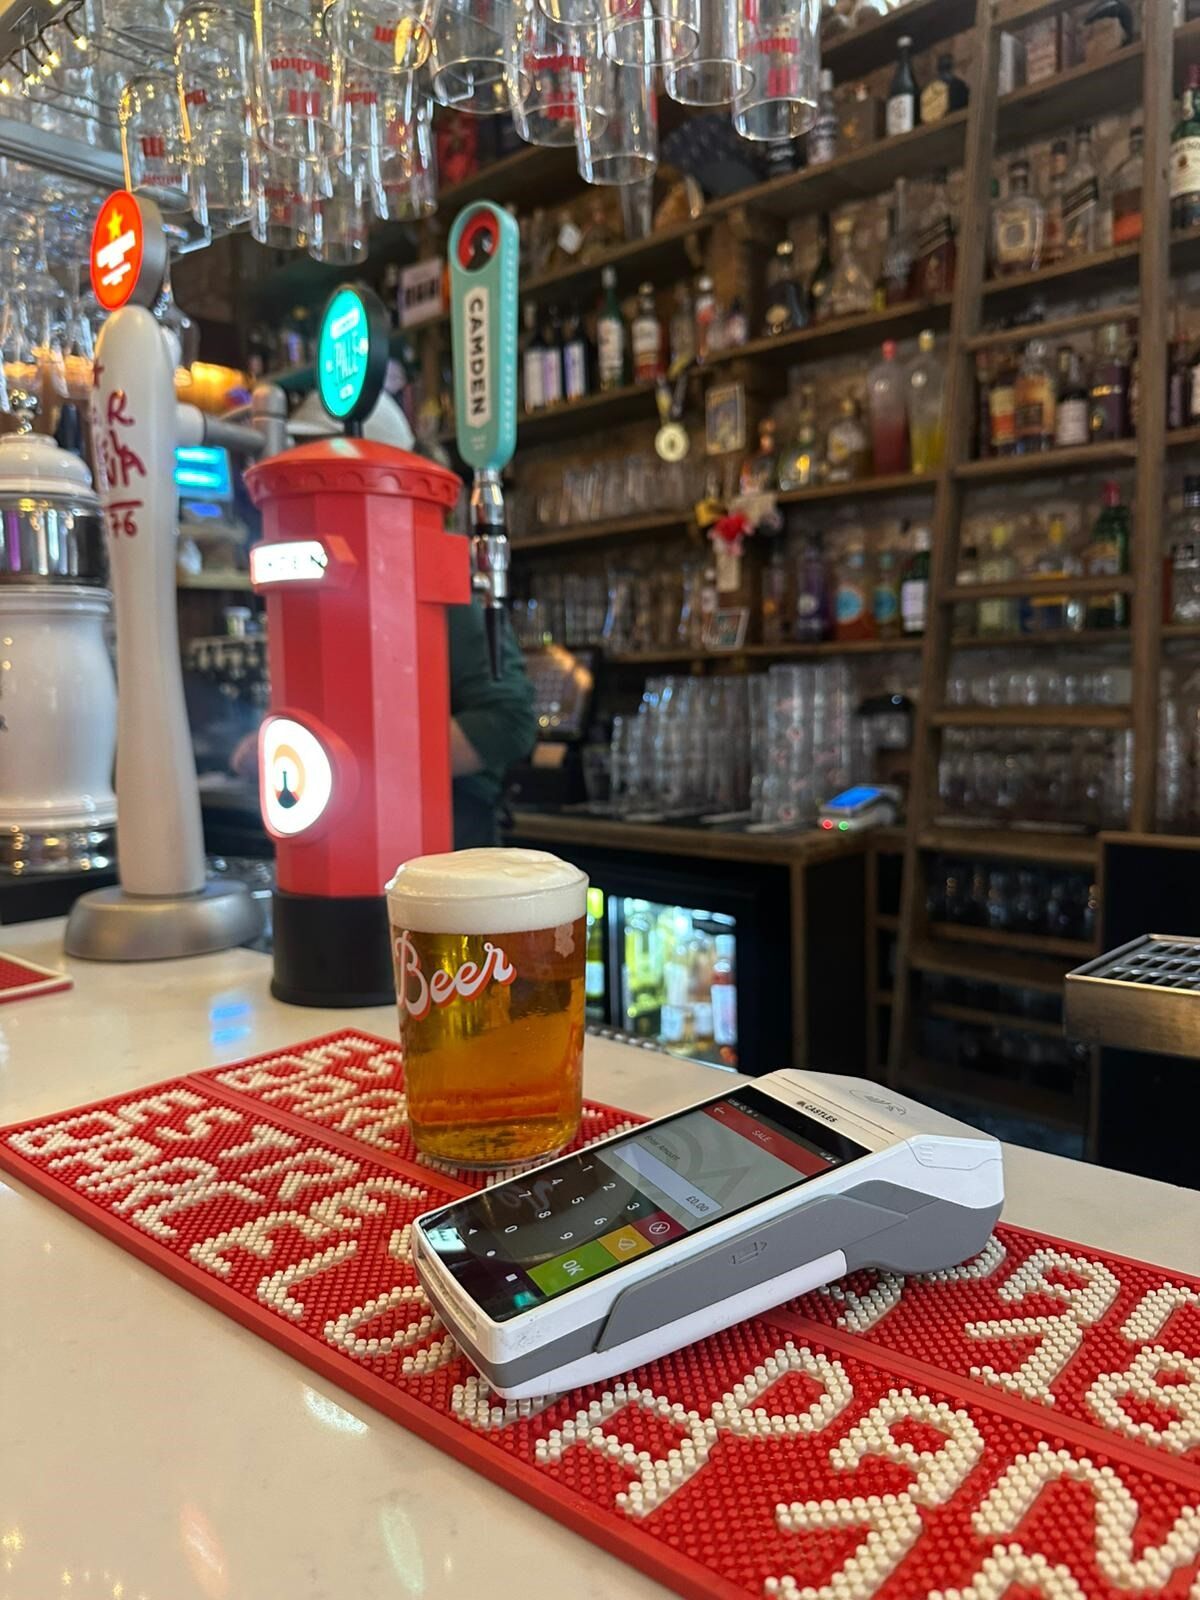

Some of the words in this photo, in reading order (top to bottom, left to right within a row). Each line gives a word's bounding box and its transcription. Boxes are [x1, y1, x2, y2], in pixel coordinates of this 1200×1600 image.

[467, 297, 487, 416] CAMDEN
[395, 930, 517, 1021] Beer
[804, 1103, 839, 1124] CASTLES
[751, 1129, 772, 1143] SALE
[551, 1177, 564, 1186] 4
[571, 1196, 585, 1205] 5
[594, 1216, 608, 1226] 6
[582, 1164, 594, 1172] 1
[602, 1182, 617, 1192] 2
[626, 1202, 641, 1212] 3
[685, 1195, 710, 1212] £0.00
[504, 1224, 518, 1234] 0
[518, 1190, 532, 1199] 7
[538, 1210, 552, 1219] 8
[559, 1231, 574, 1241] 9
[562, 1259, 585, 1277] OK
